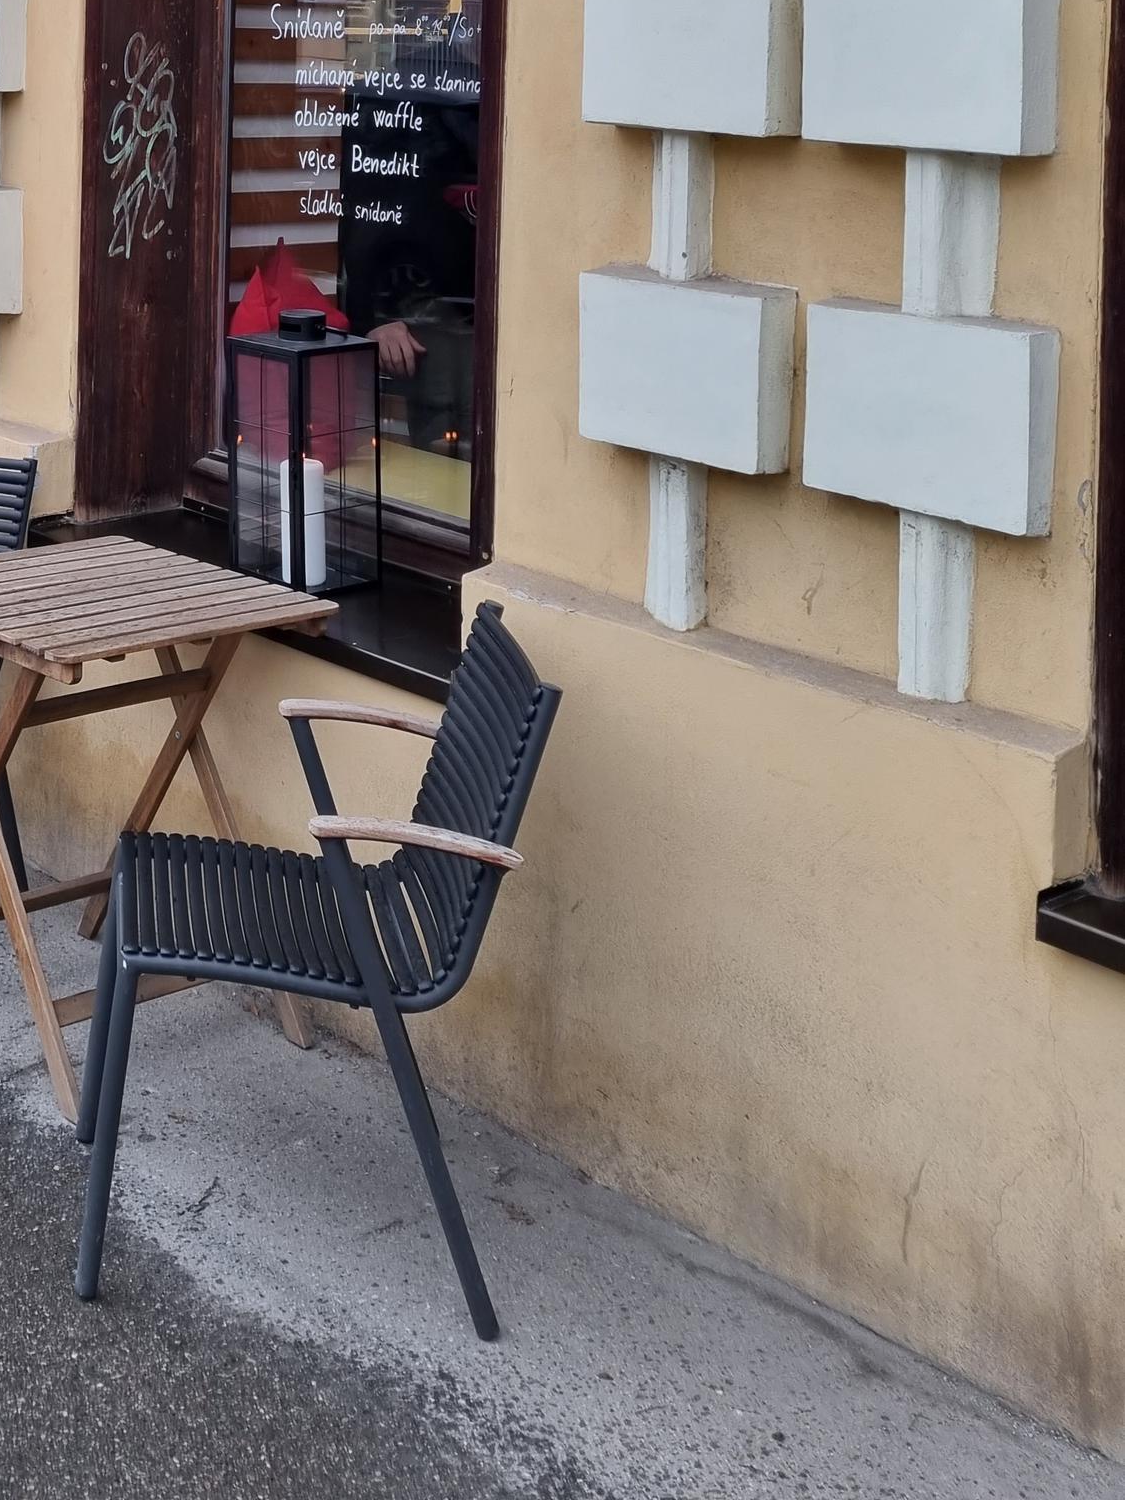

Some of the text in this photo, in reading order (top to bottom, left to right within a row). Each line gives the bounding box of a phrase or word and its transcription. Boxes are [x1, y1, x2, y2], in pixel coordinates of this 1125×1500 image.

[270, 3, 346, 40] Snídaně
[295, 58, 357, 87] míchaná
[364, 66, 404, 95] vejce
[410, 72, 427, 89] se
[294, 98, 423, 131] obložené waffle
[298, 143, 420, 178] vejce Benedikt
[299, 187, 403, 225] sladká snídaně
